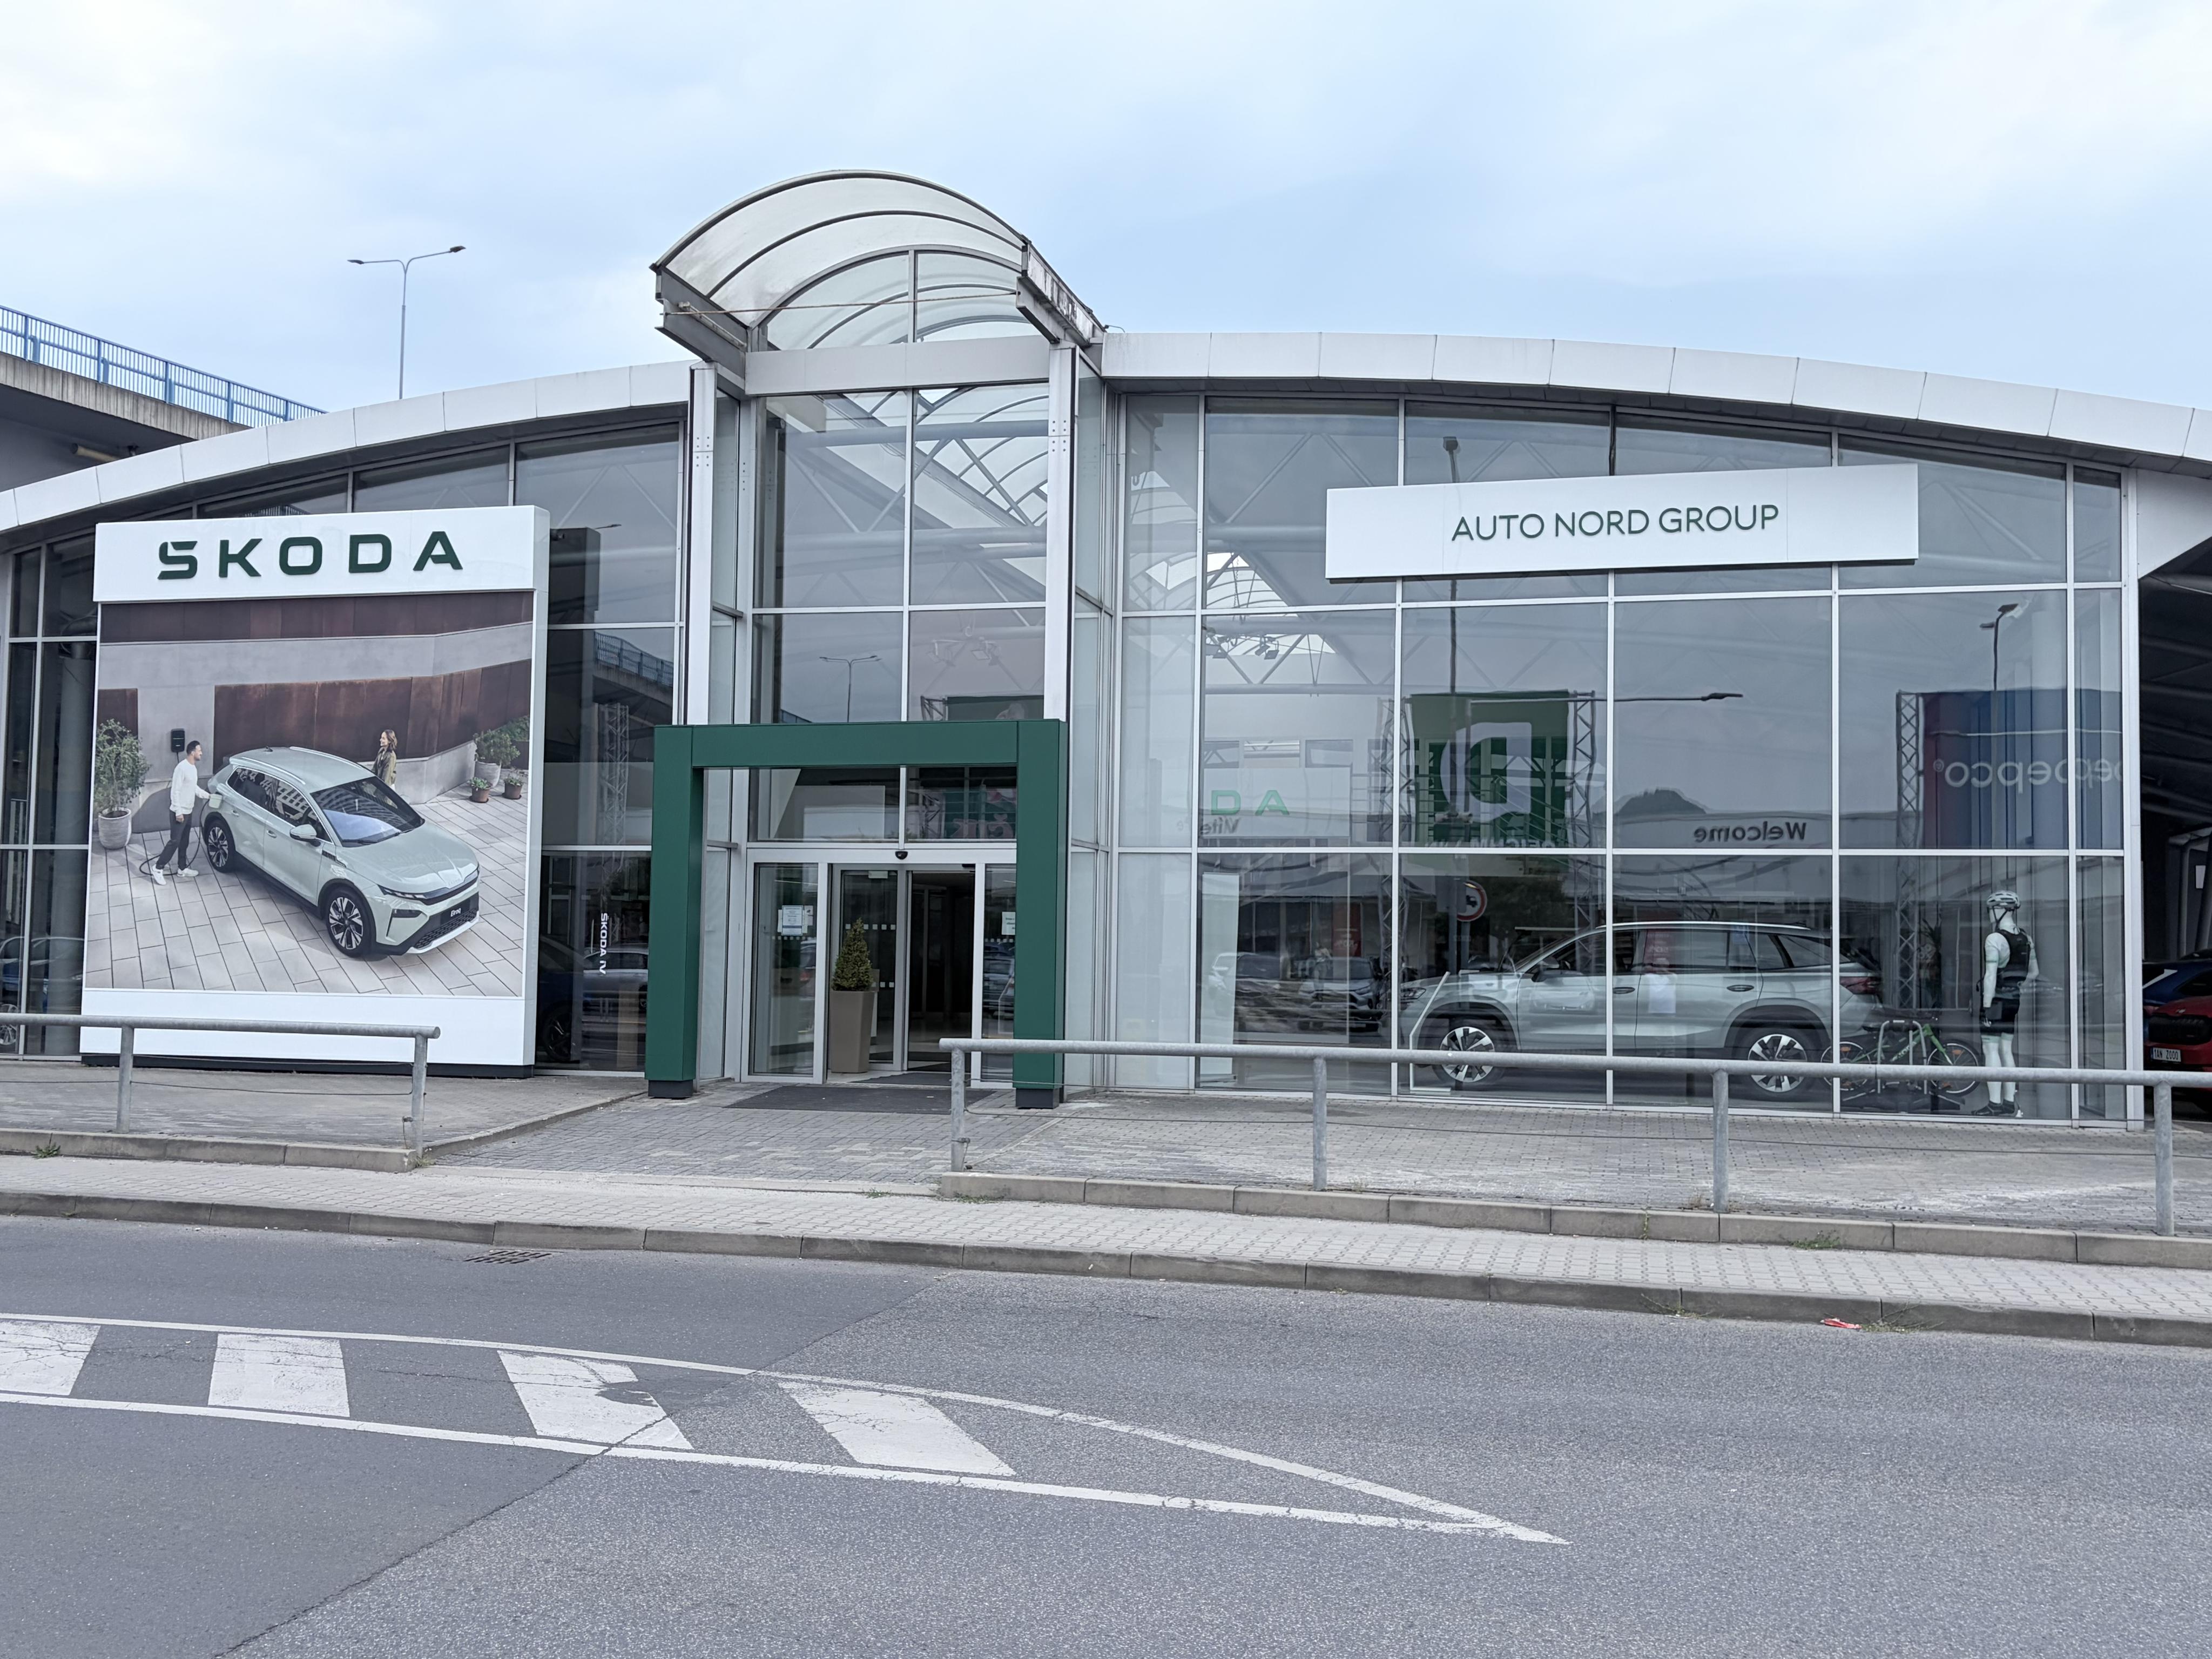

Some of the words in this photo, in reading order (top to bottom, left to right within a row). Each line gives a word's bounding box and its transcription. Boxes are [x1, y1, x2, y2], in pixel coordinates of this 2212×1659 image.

[1451, 513, 1545, 541] AUTO
[1555, 509, 1650, 537] NORD
[1658, 504, 1779, 534] GROUP
